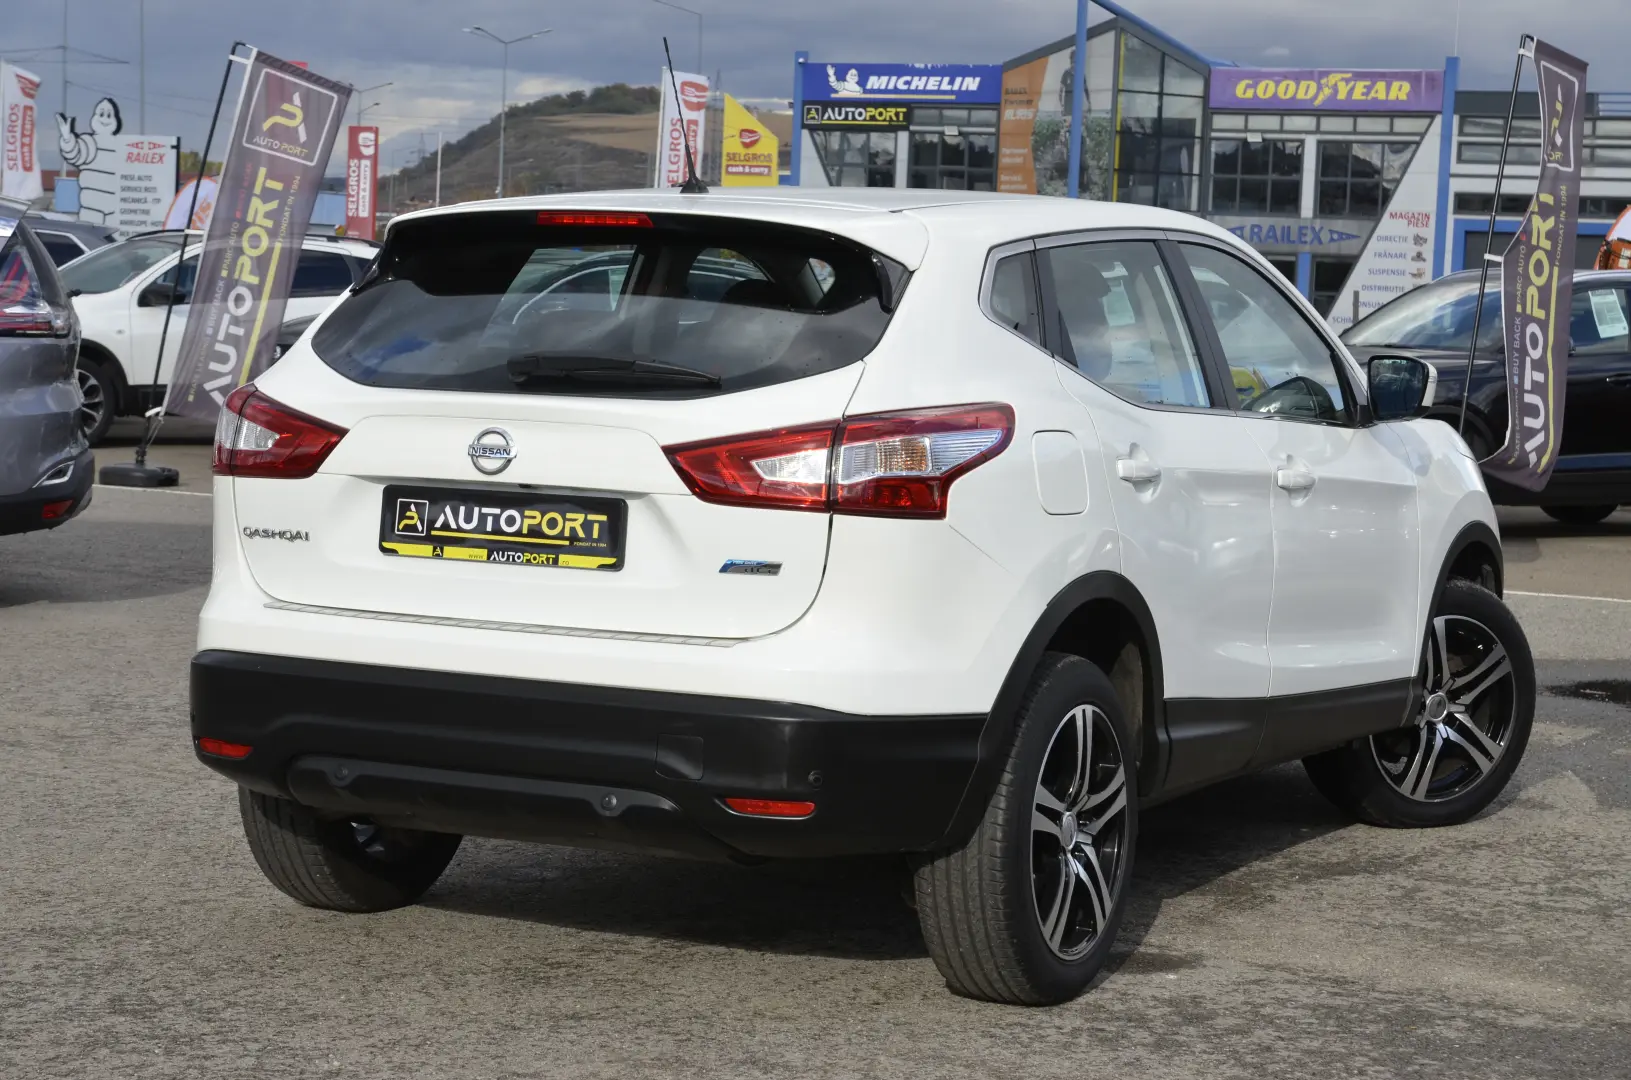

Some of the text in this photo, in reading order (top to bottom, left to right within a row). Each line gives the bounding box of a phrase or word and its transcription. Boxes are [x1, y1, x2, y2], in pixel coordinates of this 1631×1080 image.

[866, 76, 981, 91] MICHELIN
[823, 108, 907, 121] AUTOPORT
[7, 104, 20, 171] SELGROS
[126, 152, 165, 164] RAILEX
[667, 118, 683, 187] ELGROS
[726, 152, 772, 162] SELGROS
[348, 159, 359, 217] SELGROS
[279, 205, 292, 243] FONDAT
[1389, 212, 1430, 221] MAGAZIN
[1408, 219, 1430, 228] PIESE
[1560, 211, 1566, 221] IN
[1249, 224, 1324, 246] RAILEX
[1556, 224, 1566, 265] FONDAT
[1368, 268, 1406, 276] SUSPENSIE
[203, 167, 284, 406] AUTOPORT
[1516, 273, 1524, 303] PARC
[1514, 317, 1522, 349] BACK
[472, 446, 511, 456] NISSAN
[434, 504, 607, 539] AUTOPORT
[243, 527, 310, 543] QASHQAI
[490, 551, 556, 565] AUTOPORT
